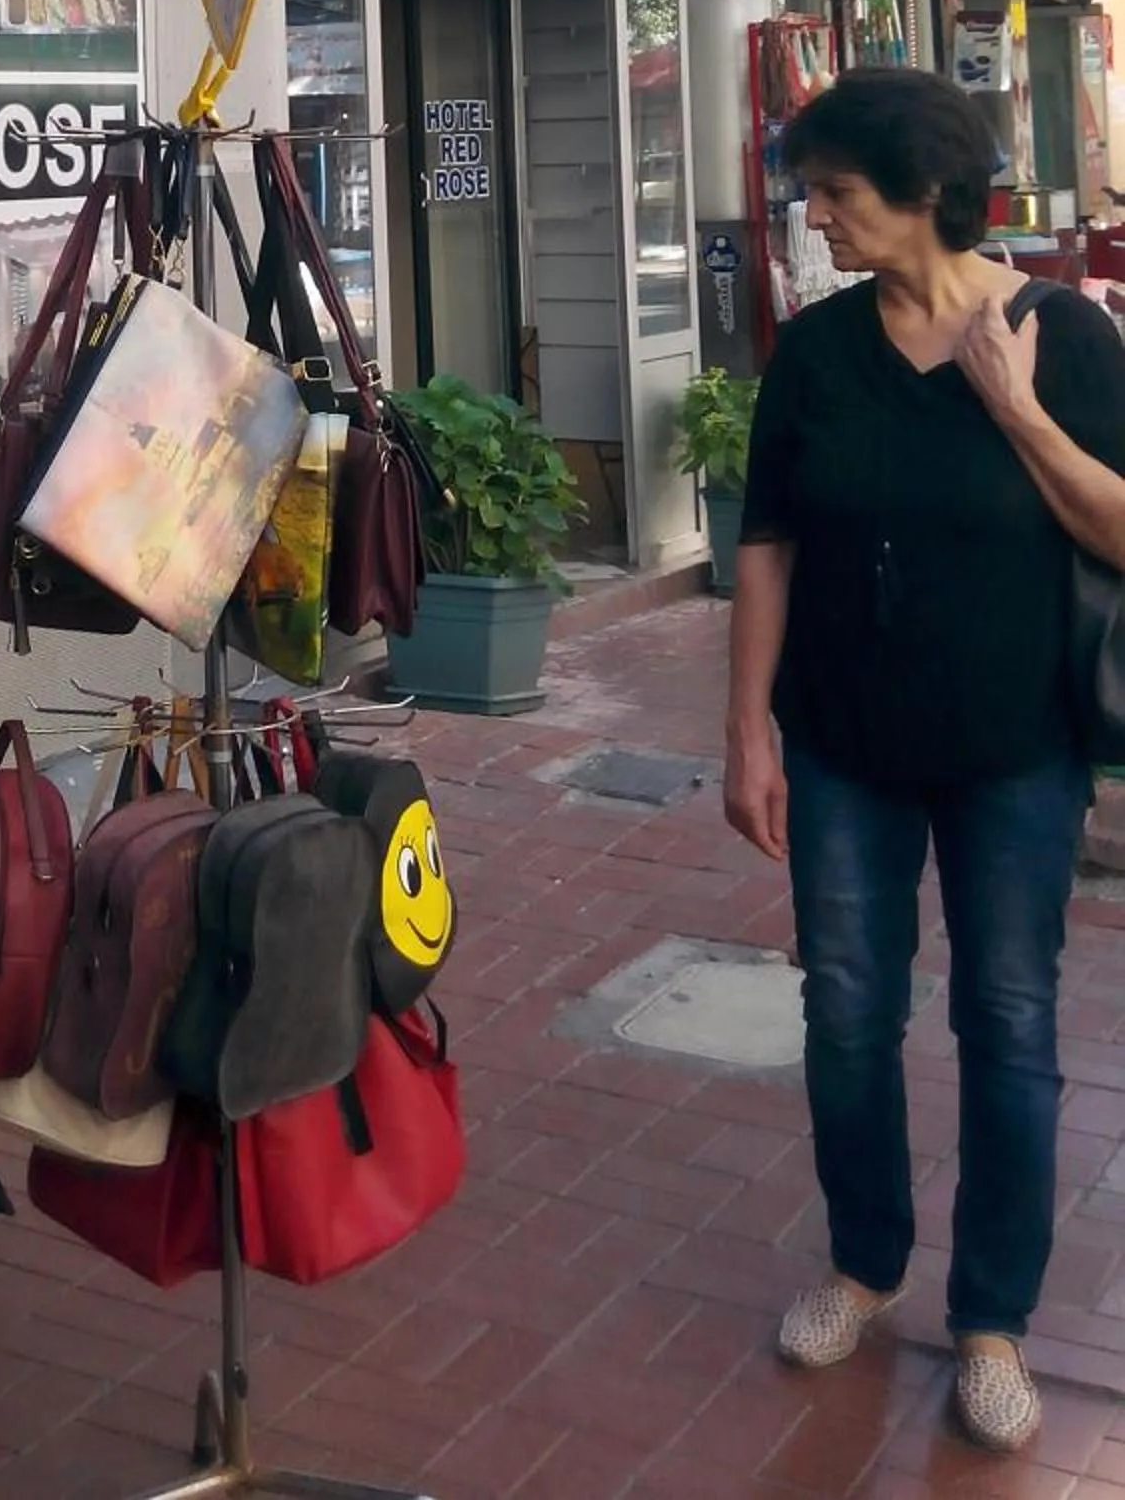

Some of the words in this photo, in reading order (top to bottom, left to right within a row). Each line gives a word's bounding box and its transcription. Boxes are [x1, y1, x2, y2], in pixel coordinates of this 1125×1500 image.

[425, 100, 494, 132] HOTEL
[439, 134, 483, 165] RED
[434, 167, 489, 201] ROSE
